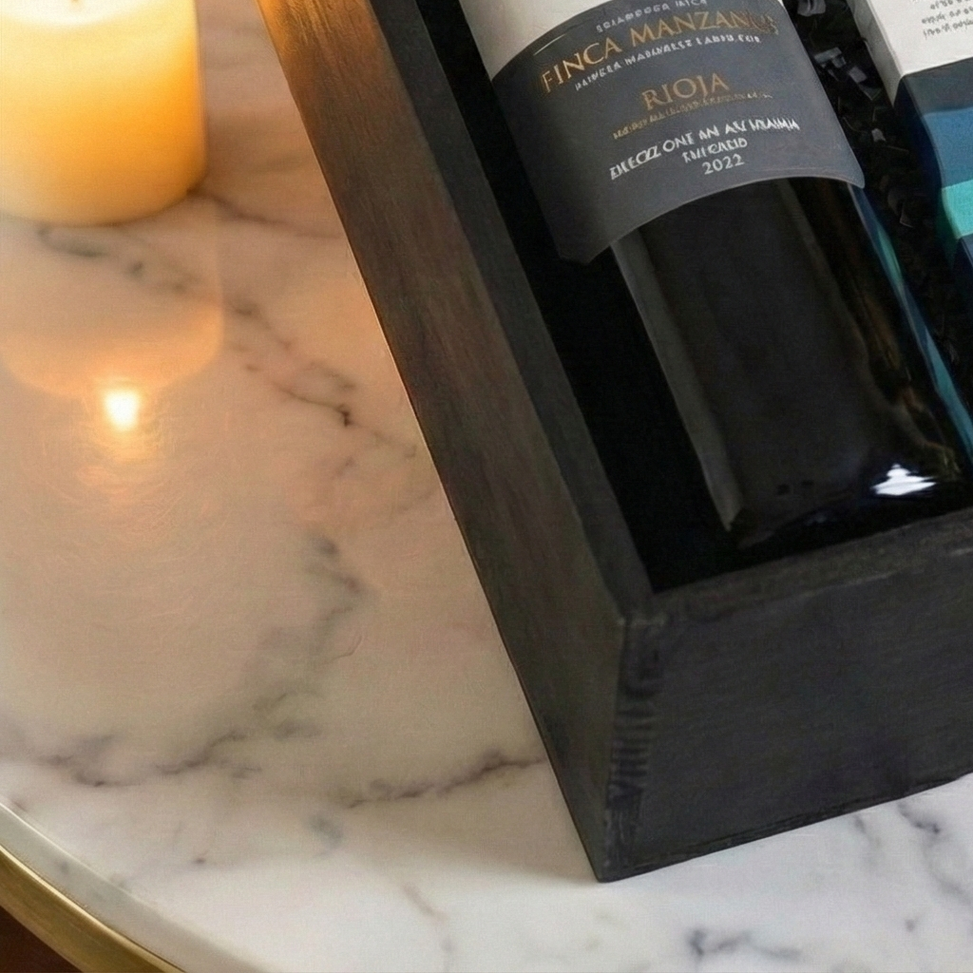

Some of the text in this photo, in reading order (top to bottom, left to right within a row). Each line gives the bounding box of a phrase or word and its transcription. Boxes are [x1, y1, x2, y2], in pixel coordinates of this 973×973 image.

[541, 36, 623, 94] FINCA
[641, 72, 730, 110] RIOJA
[702, 153, 746, 175] 2022
